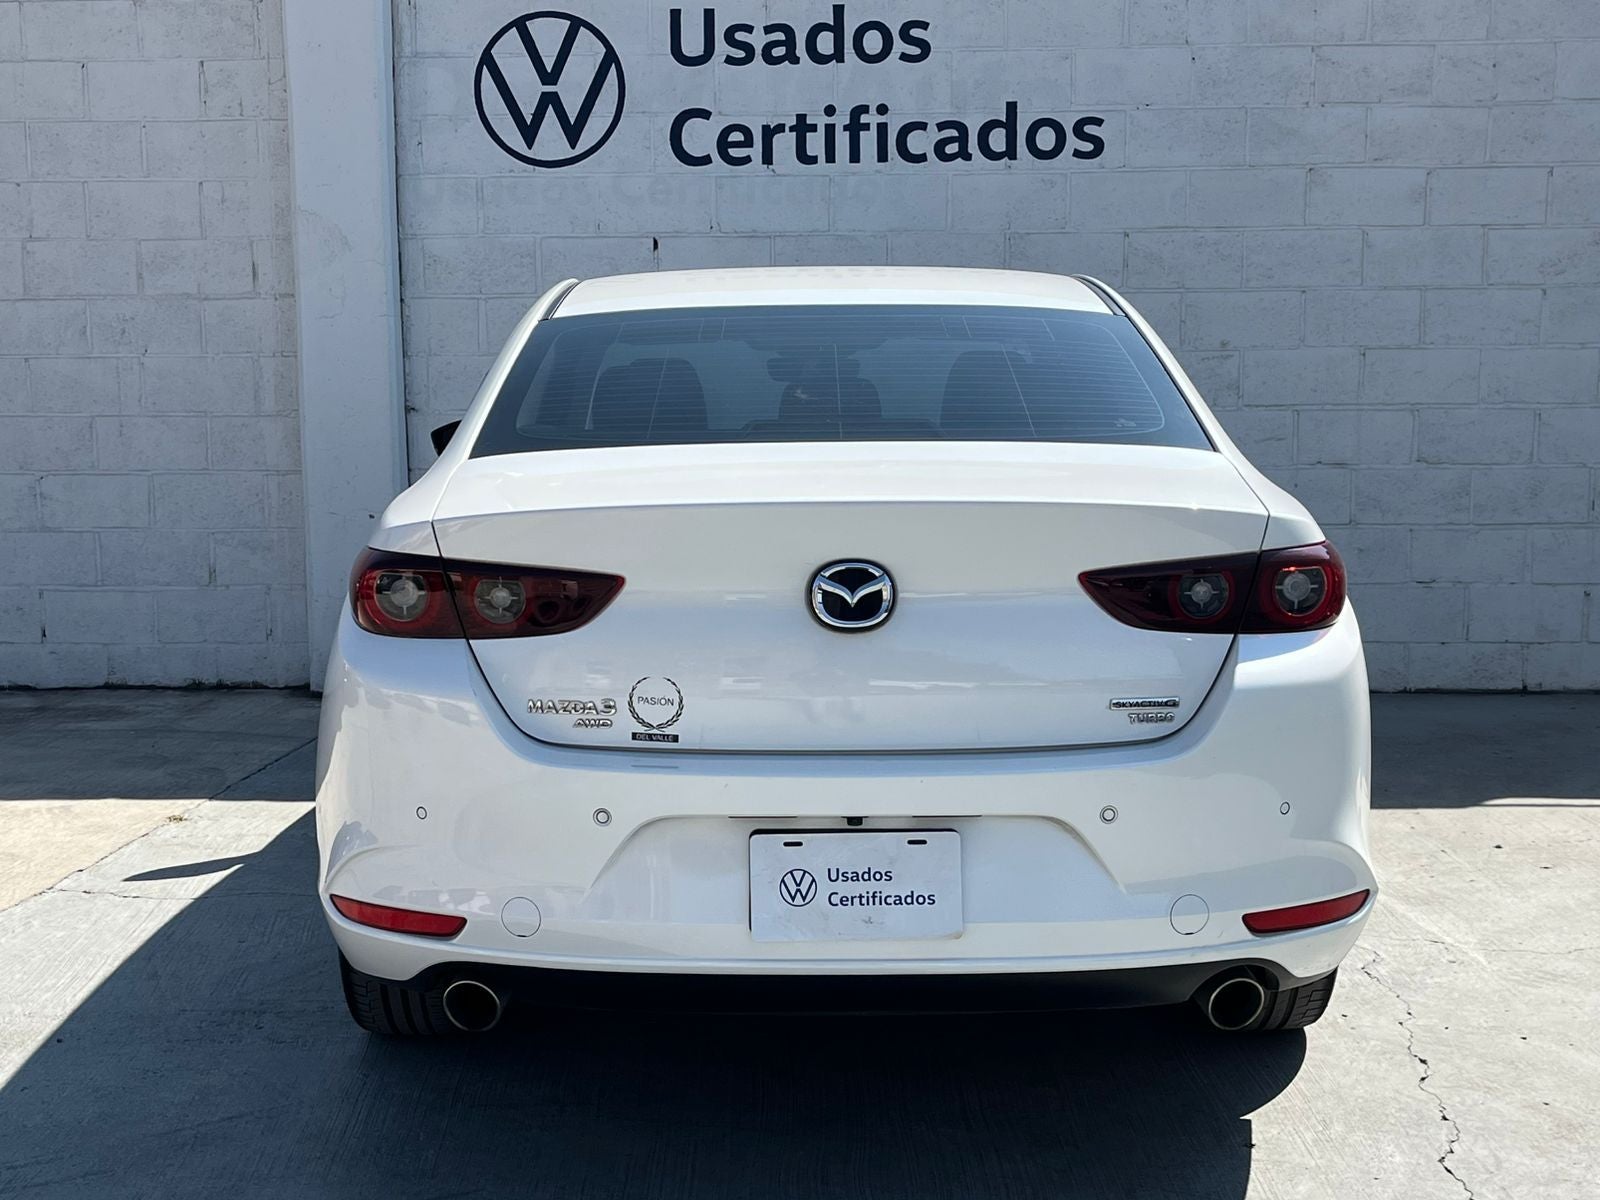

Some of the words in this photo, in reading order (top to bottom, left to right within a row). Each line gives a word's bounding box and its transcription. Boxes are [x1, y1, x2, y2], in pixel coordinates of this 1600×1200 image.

[670, 3, 932, 66] Usados
[670, 100, 1105, 168] Certificados
[637, 694, 675, 707] PASIÓN
[573, 717, 614, 729] AWD
[1128, 711, 1176, 724] TURBO
[827, 866, 893, 883] Usados
[827, 890, 936, 907] Certificados
